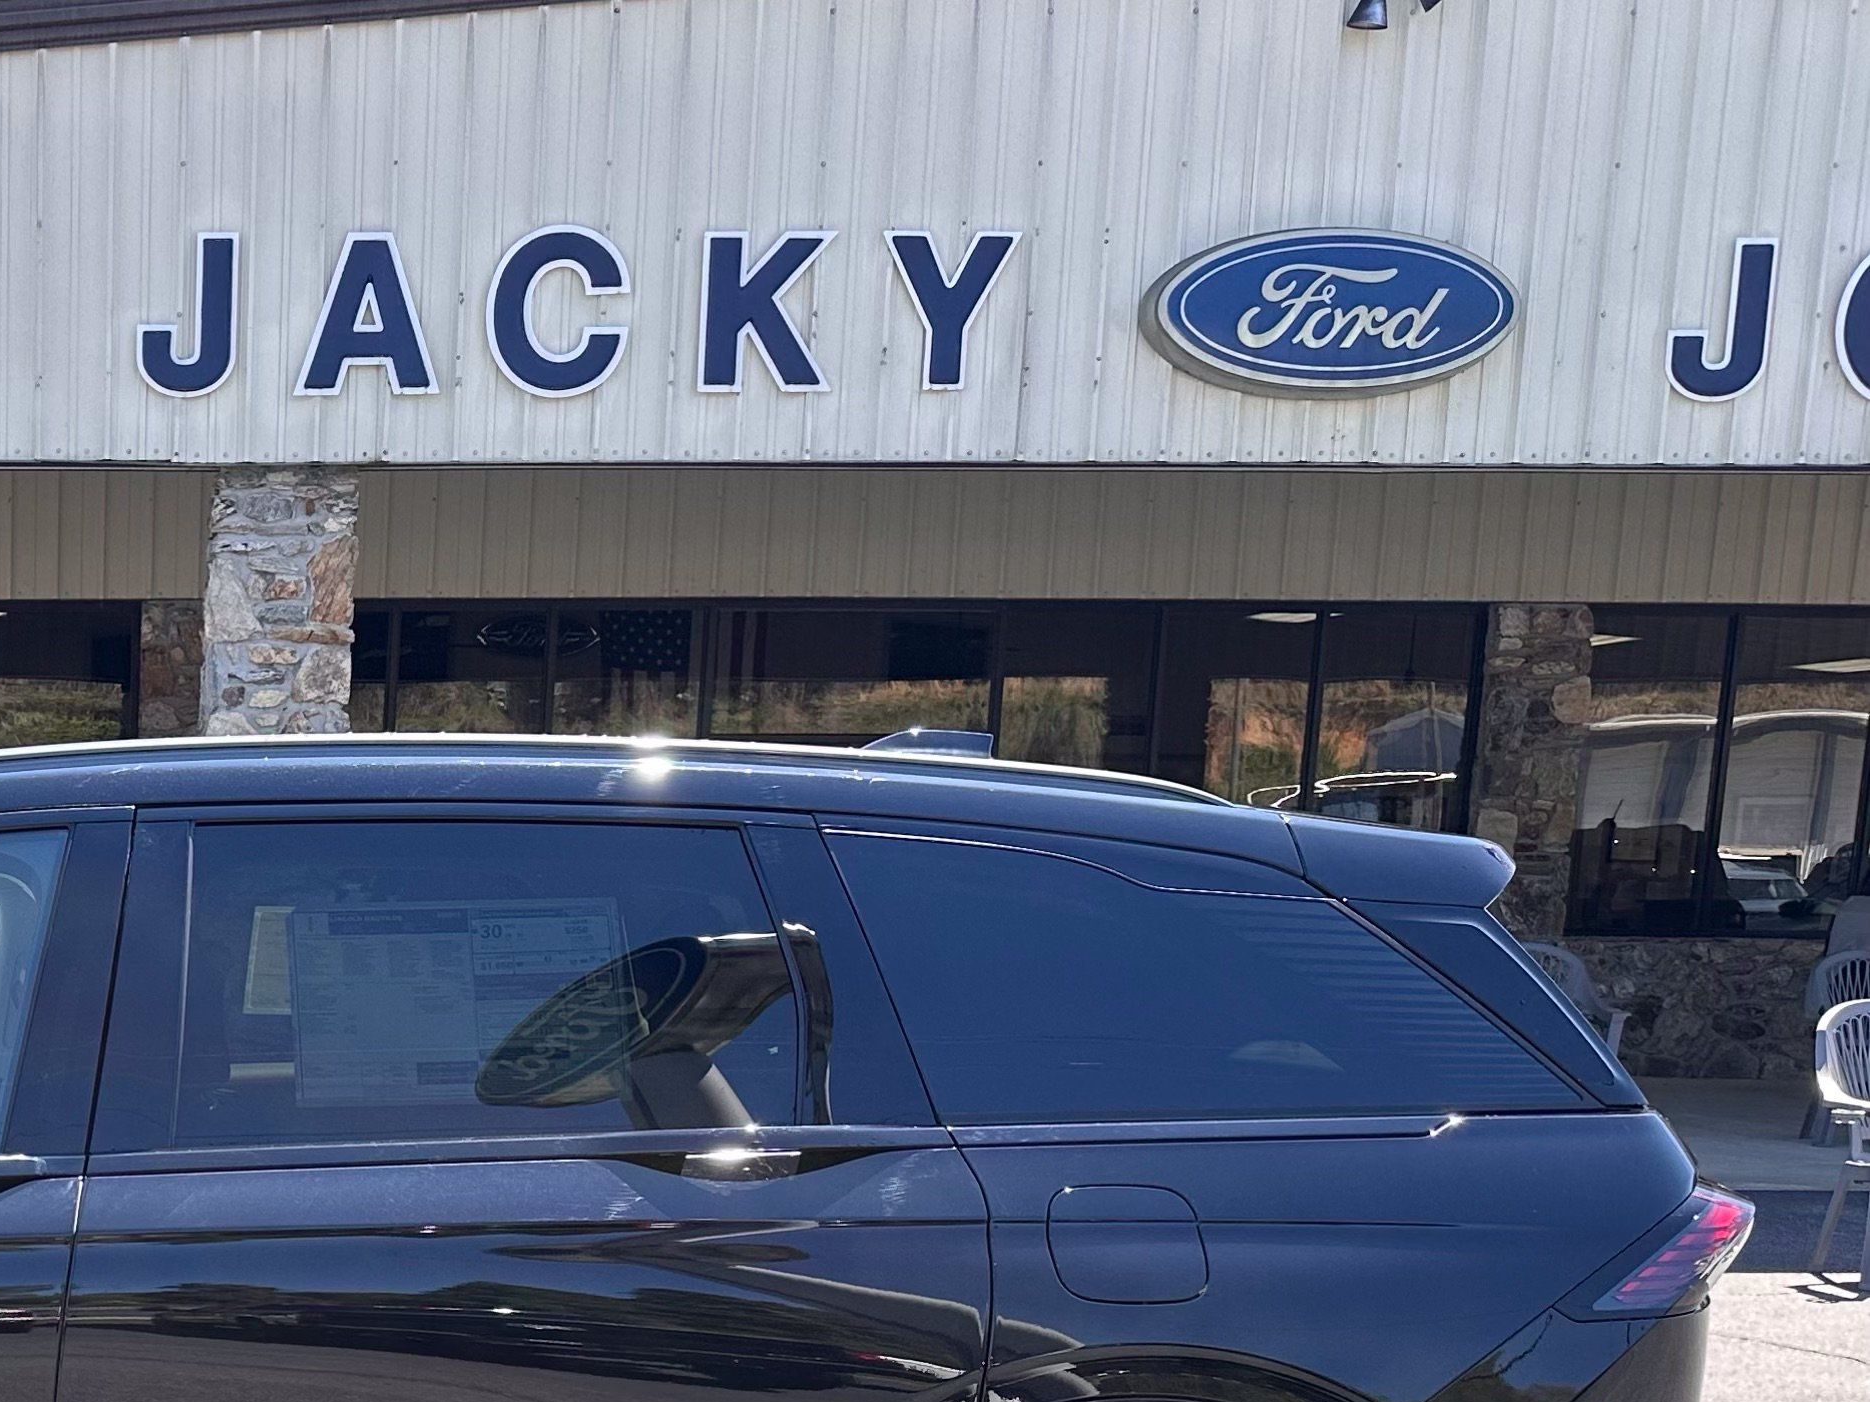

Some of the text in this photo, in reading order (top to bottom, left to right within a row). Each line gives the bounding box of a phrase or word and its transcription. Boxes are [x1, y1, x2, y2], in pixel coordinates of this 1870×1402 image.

[137, 224, 1870, 402] JACKY J
[1237, 263, 1449, 350] Ford
[480, 924, 503, 939] 30
